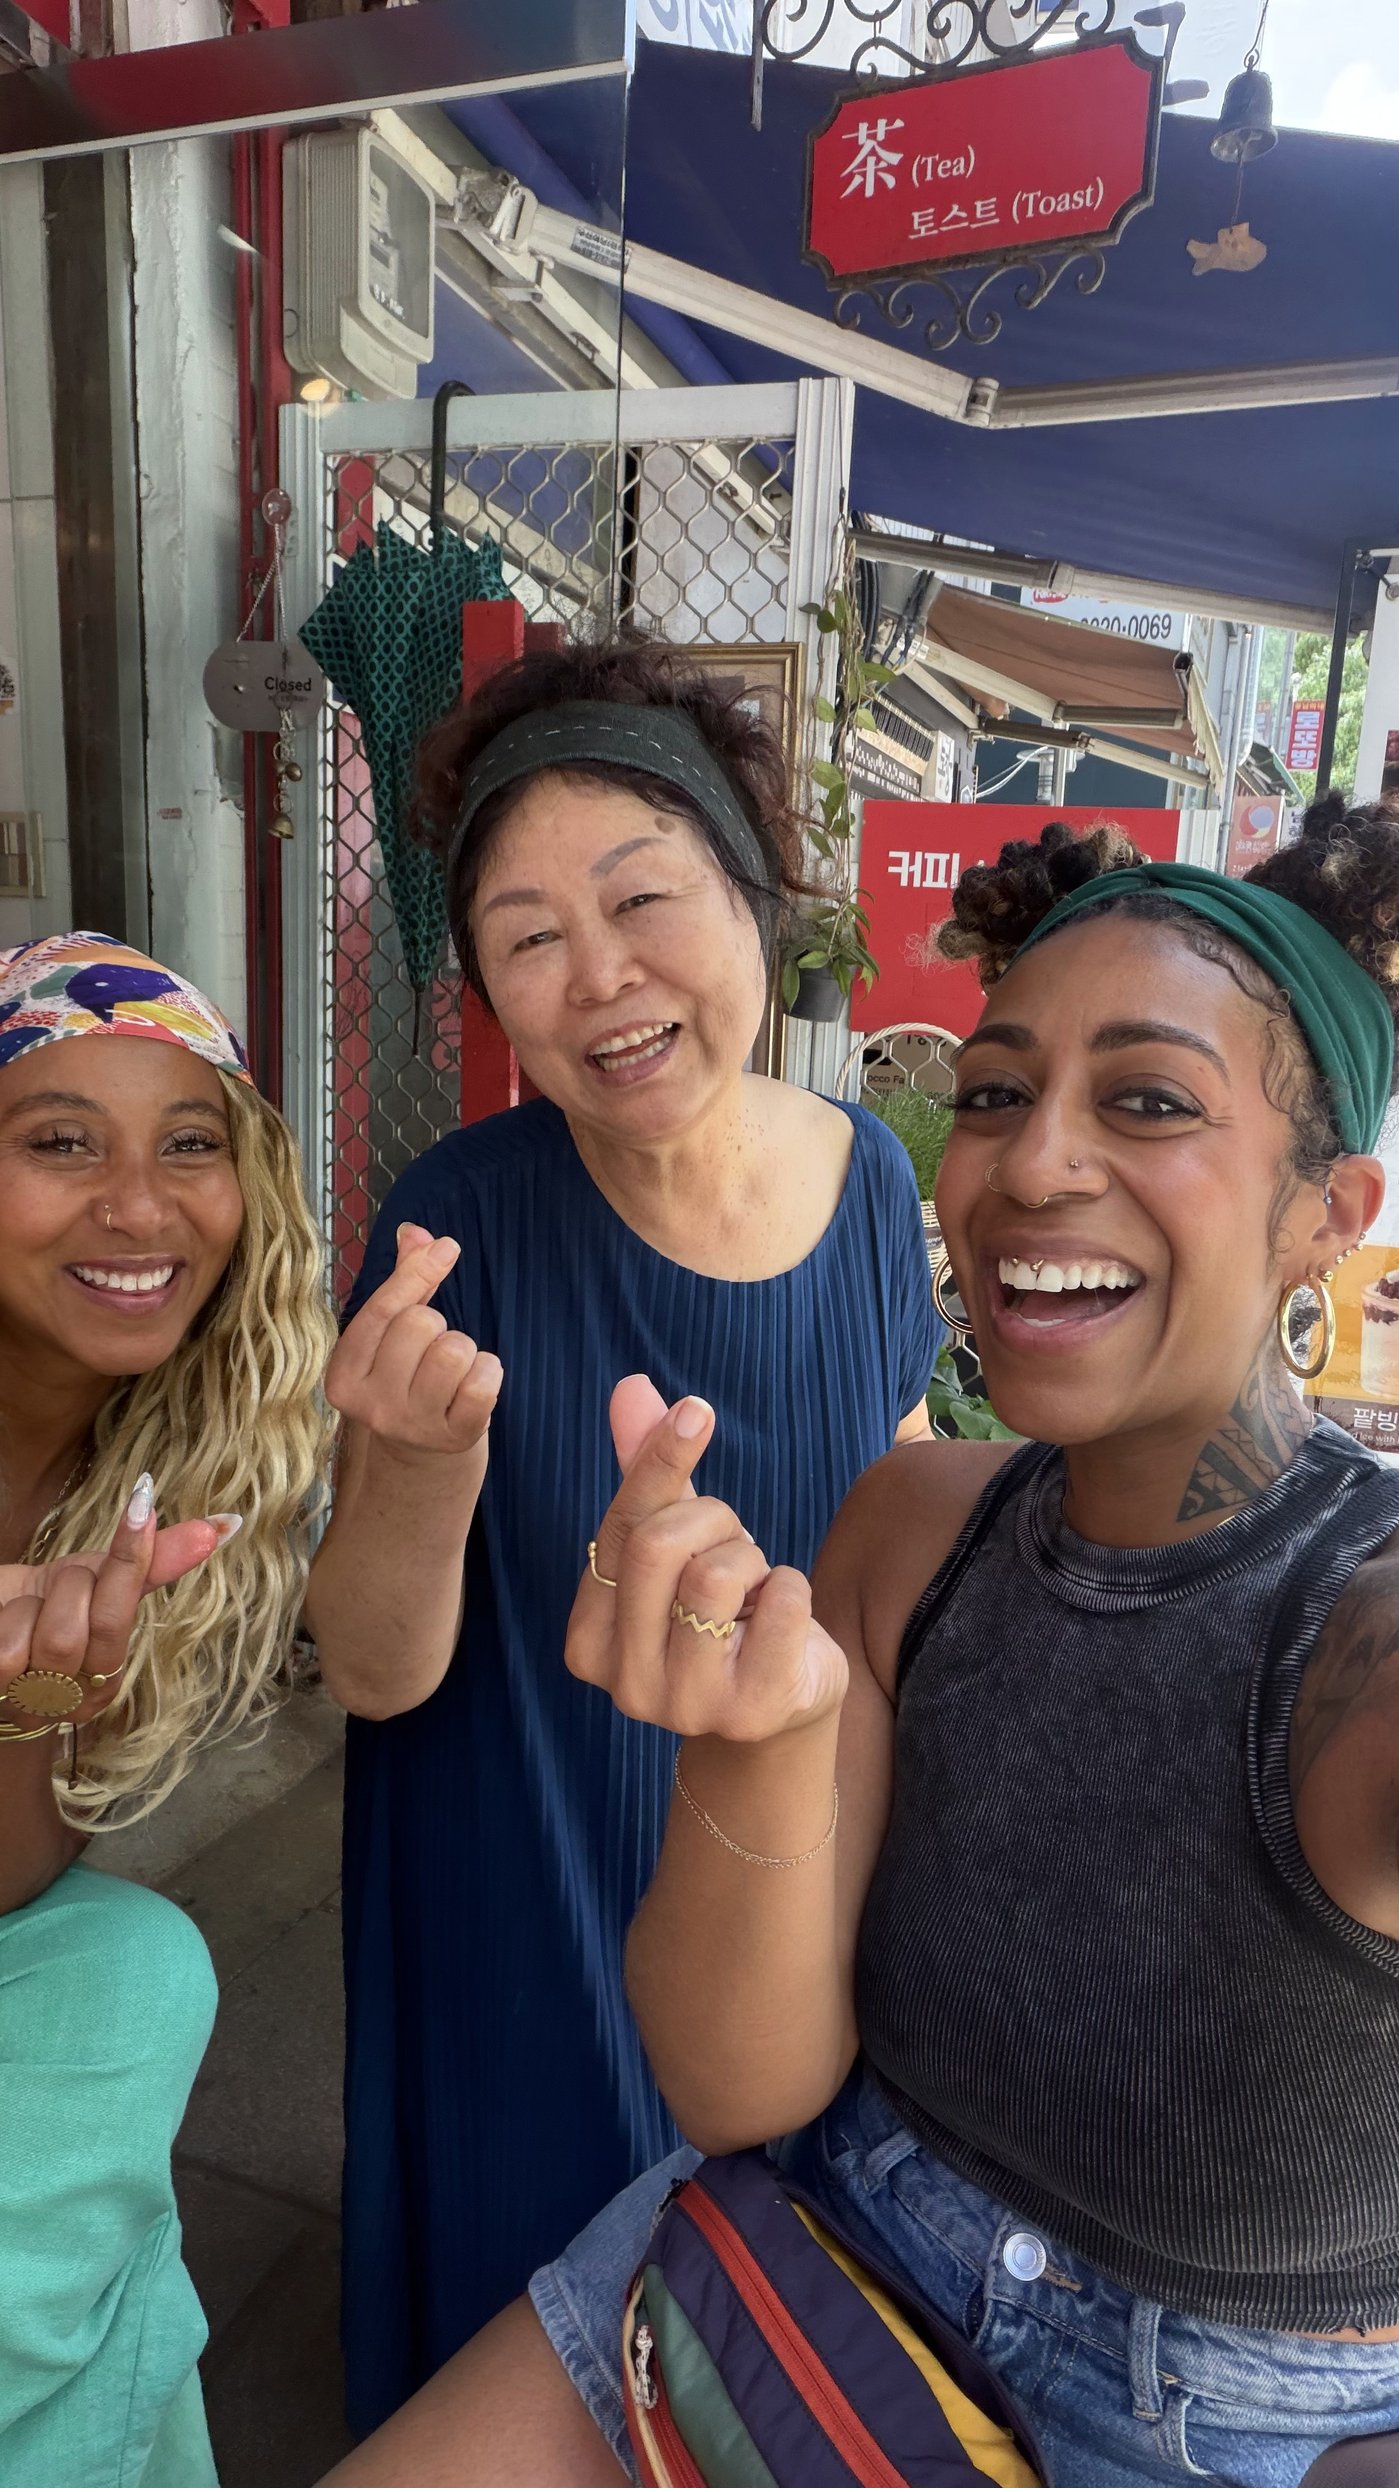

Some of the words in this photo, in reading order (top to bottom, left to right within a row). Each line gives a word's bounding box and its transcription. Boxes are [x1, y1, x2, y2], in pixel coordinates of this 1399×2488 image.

[840, 118, 905, 198] 茶
[912, 144, 975, 188] (Tea)
[908, 197, 1000, 239] 토스트
[1012, 176, 1104, 224] (Toast)
[264, 676, 312, 692] Closed
[887, 850, 984, 889] 커피
[1375, 1434, 1396, 1445] with
